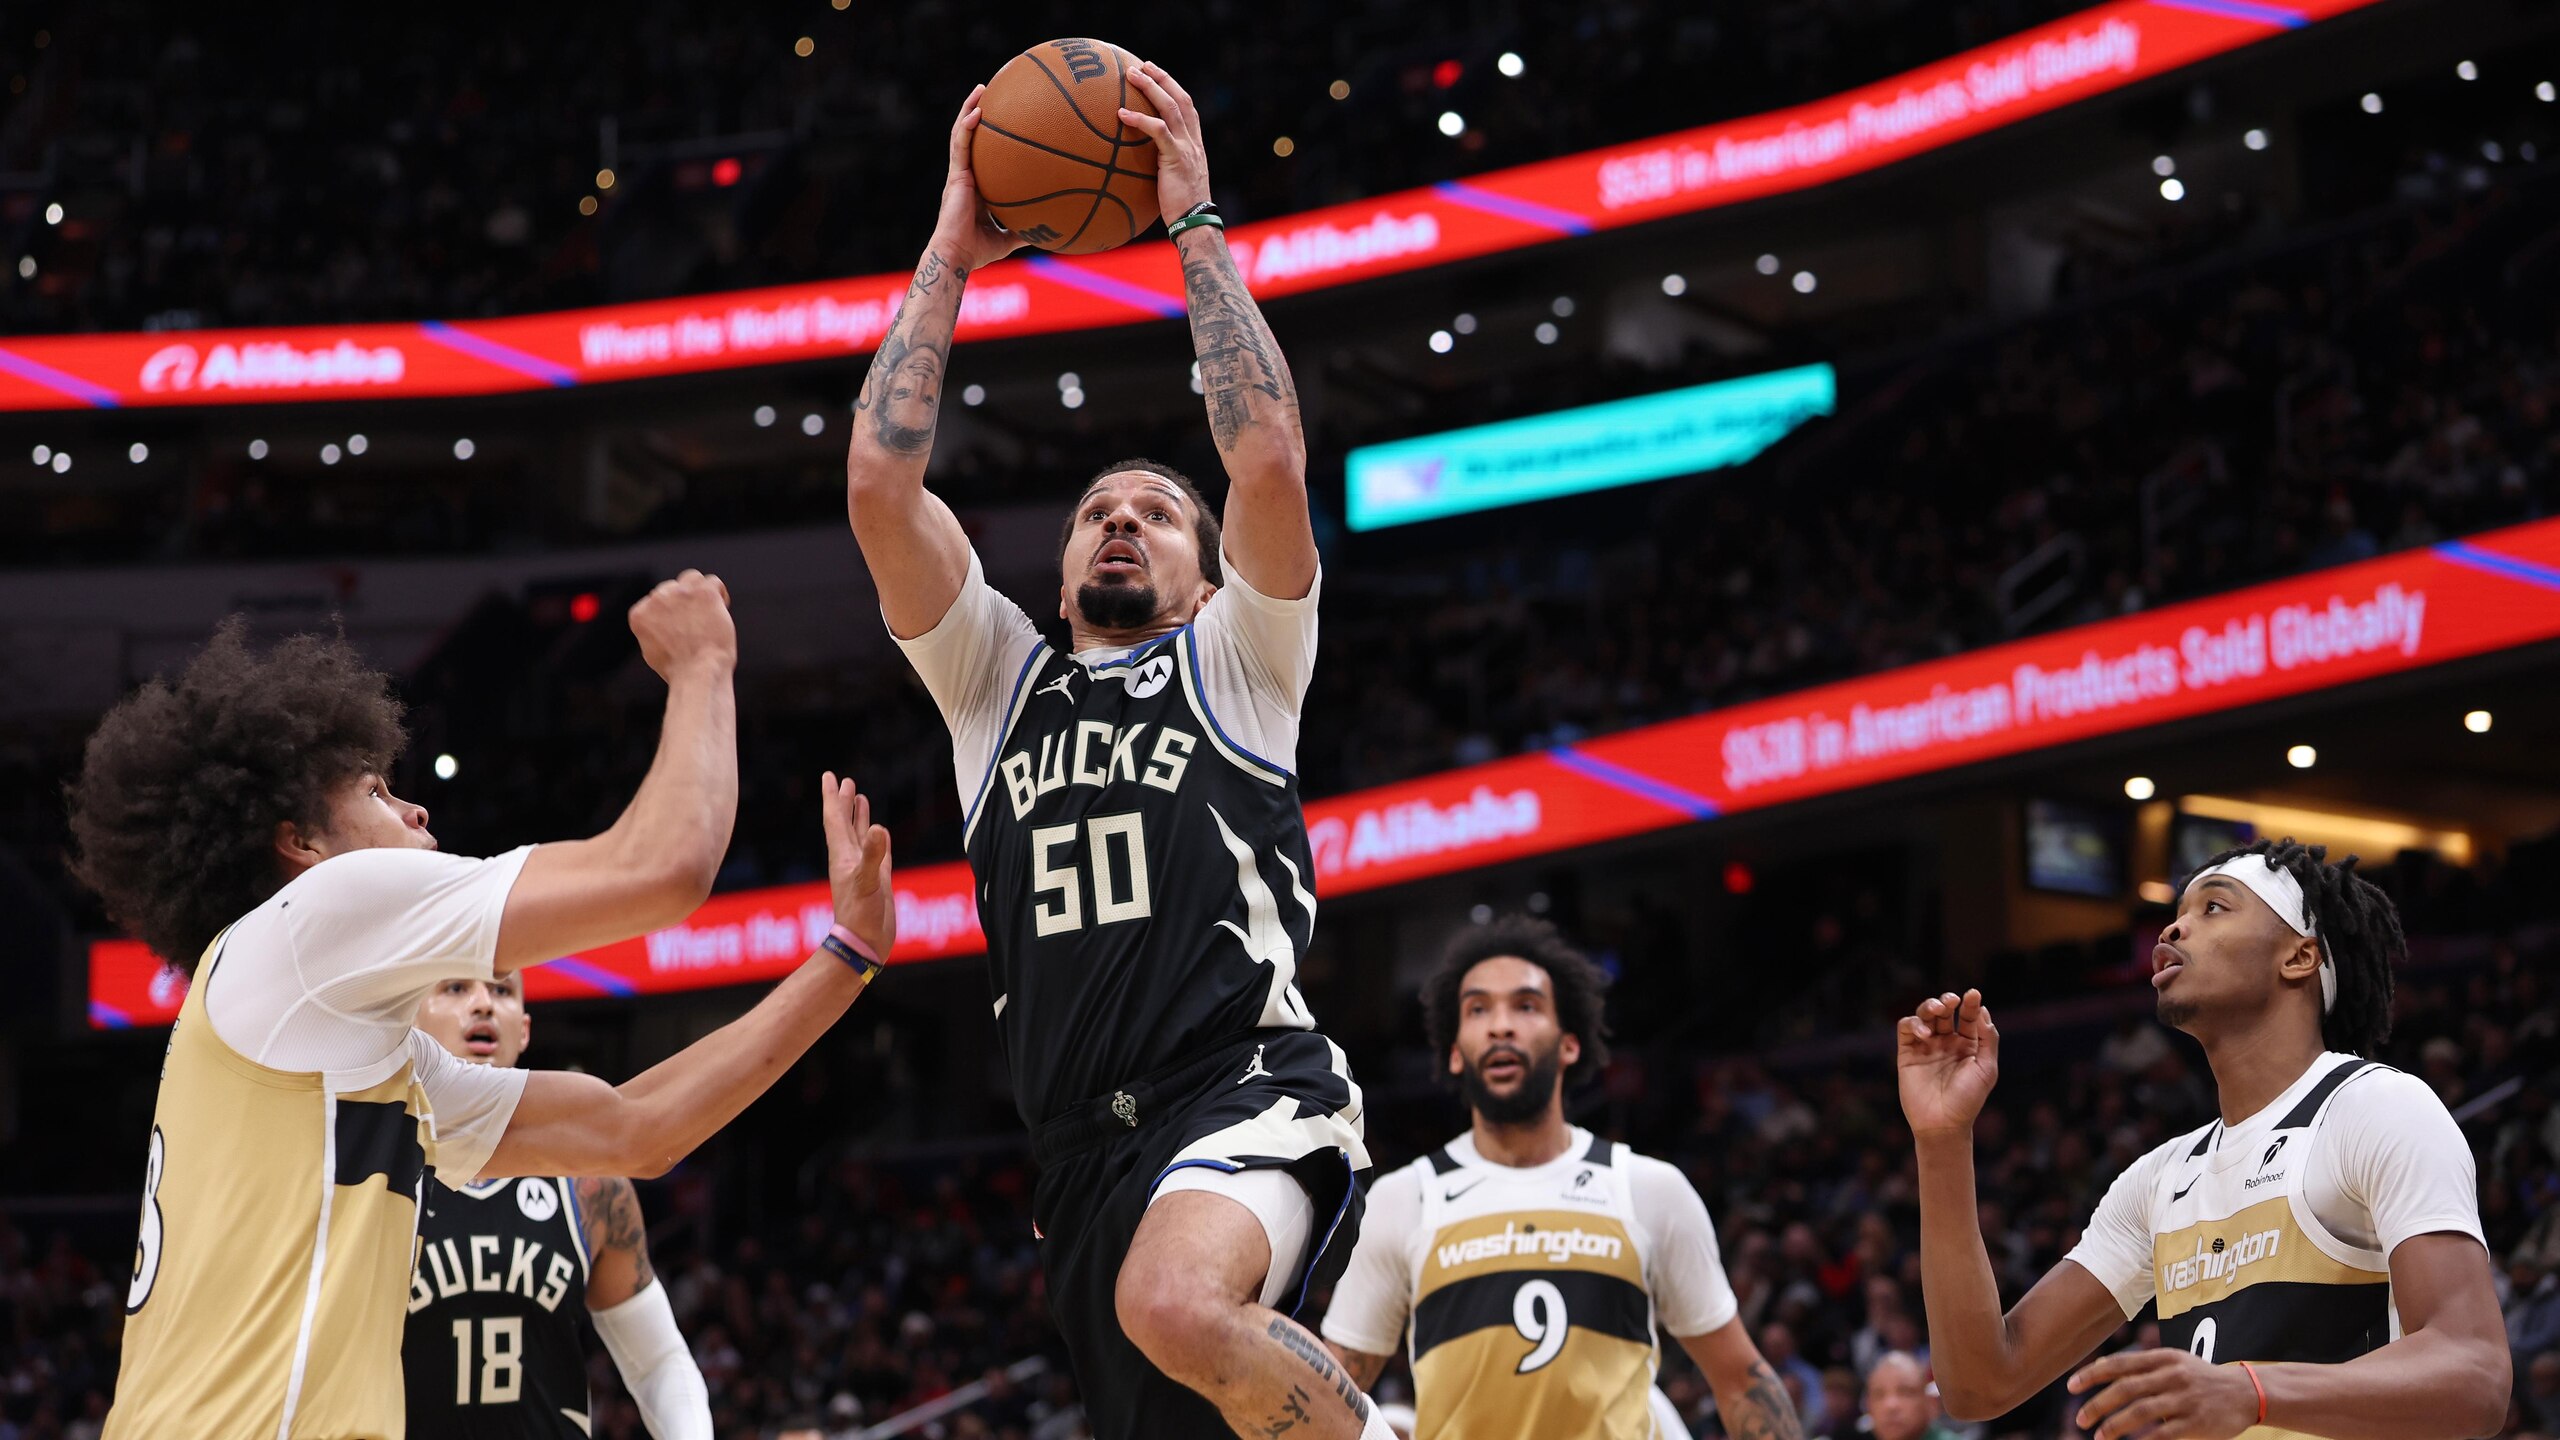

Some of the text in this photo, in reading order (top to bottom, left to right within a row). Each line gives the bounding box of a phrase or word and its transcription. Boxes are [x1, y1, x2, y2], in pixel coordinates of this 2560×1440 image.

[1252, 211, 1439, 284] Alibaba
[202, 340, 404, 390] Alibaba
[580, 322, 672, 366] Where
[676, 313, 724, 356] the
[727, 305, 811, 348] World
[814, 296, 884, 347] Buys
[1807, 712, 1847, 771] in
[1849, 683, 2013, 762] American
[2012, 643, 2180, 724] Products
[2179, 613, 2268, 689] Sold
[2270, 583, 2425, 669] Globally
[1000, 719, 1198, 822] BUCKS
[1347, 785, 1541, 869] Alibaba
[1032, 811, 1151, 938] 50
[645, 919, 742, 972] Where
[746, 911, 798, 962] the
[2244, 1169, 2287, 1190] Robinhood
[407, 1234, 574, 1315] BUCKS
[452, 1316, 523, 1406] 18
[1267, 1316, 1336, 1382] COUNT
[1512, 1278, 1568, 1376] 9
